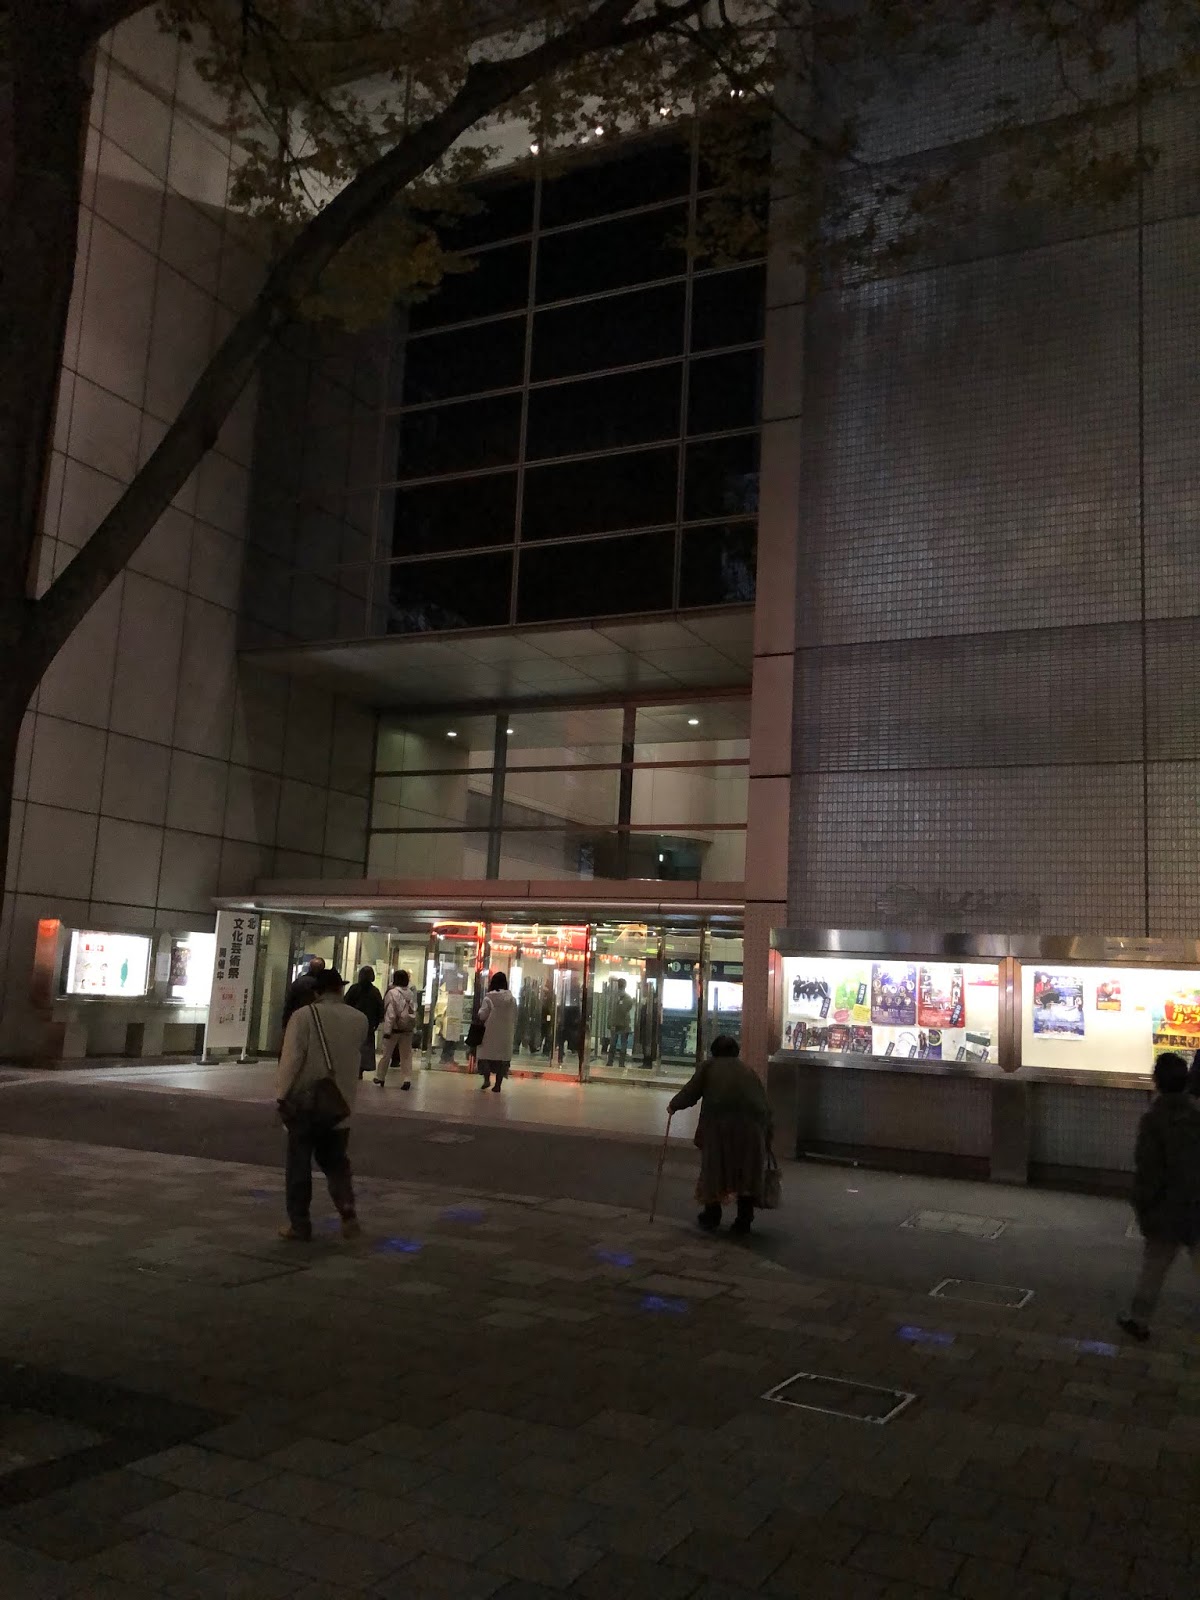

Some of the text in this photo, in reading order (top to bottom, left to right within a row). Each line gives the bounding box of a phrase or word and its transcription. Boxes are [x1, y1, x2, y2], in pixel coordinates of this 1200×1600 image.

[228, 918, 244, 979] 文化芸術祭
[246, 917, 256, 945] 北区
